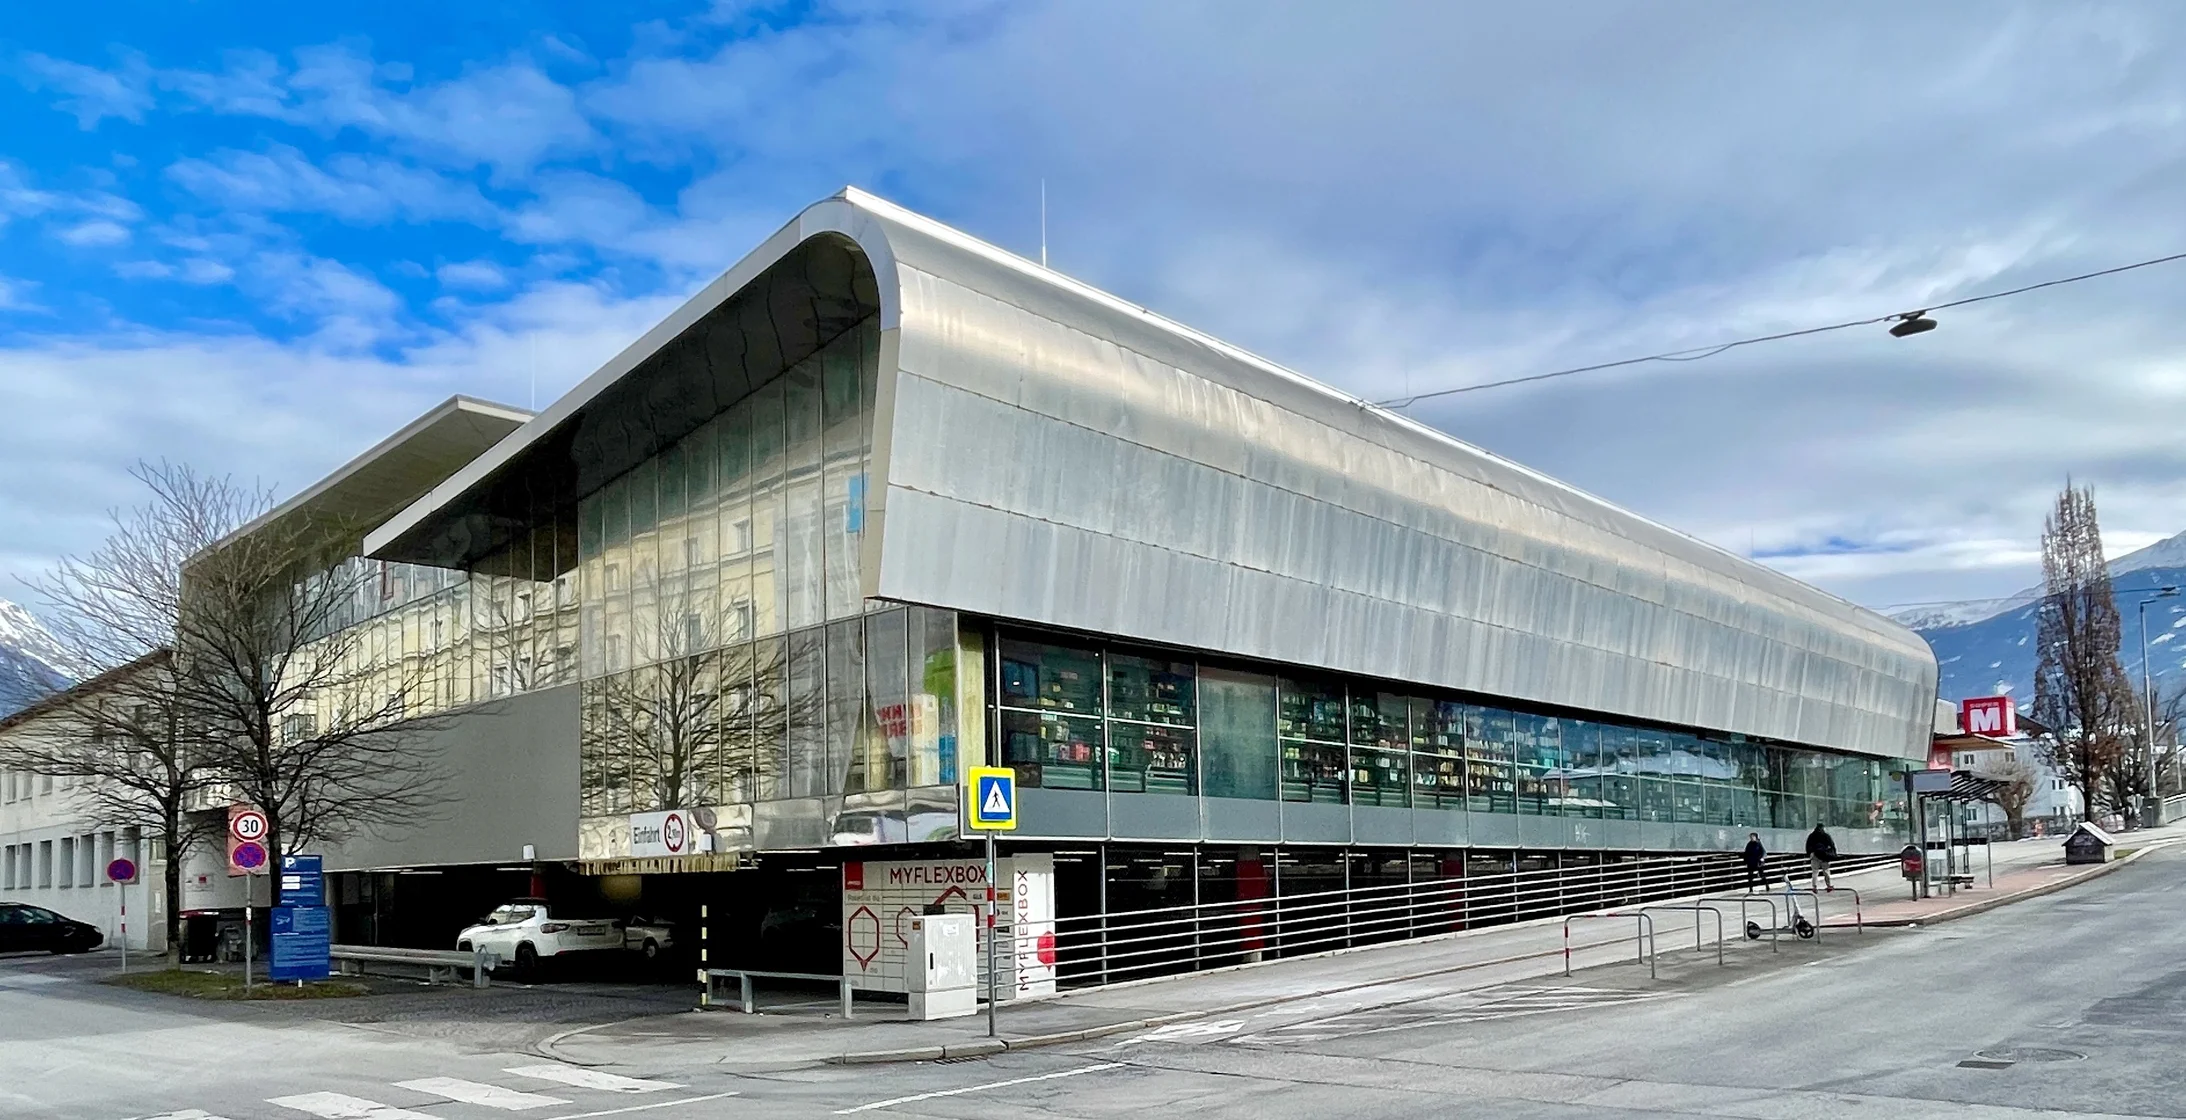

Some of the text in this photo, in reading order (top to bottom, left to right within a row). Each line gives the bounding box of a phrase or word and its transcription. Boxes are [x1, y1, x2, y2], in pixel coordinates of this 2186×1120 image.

[1970, 707, 2001, 732] M
[242, 819, 259, 833] 30
[285, 857, 296, 869] P
[889, 865, 987, 885] MYFLEXBOX
[1017, 869, 1030, 991] MYFLEXBOX
